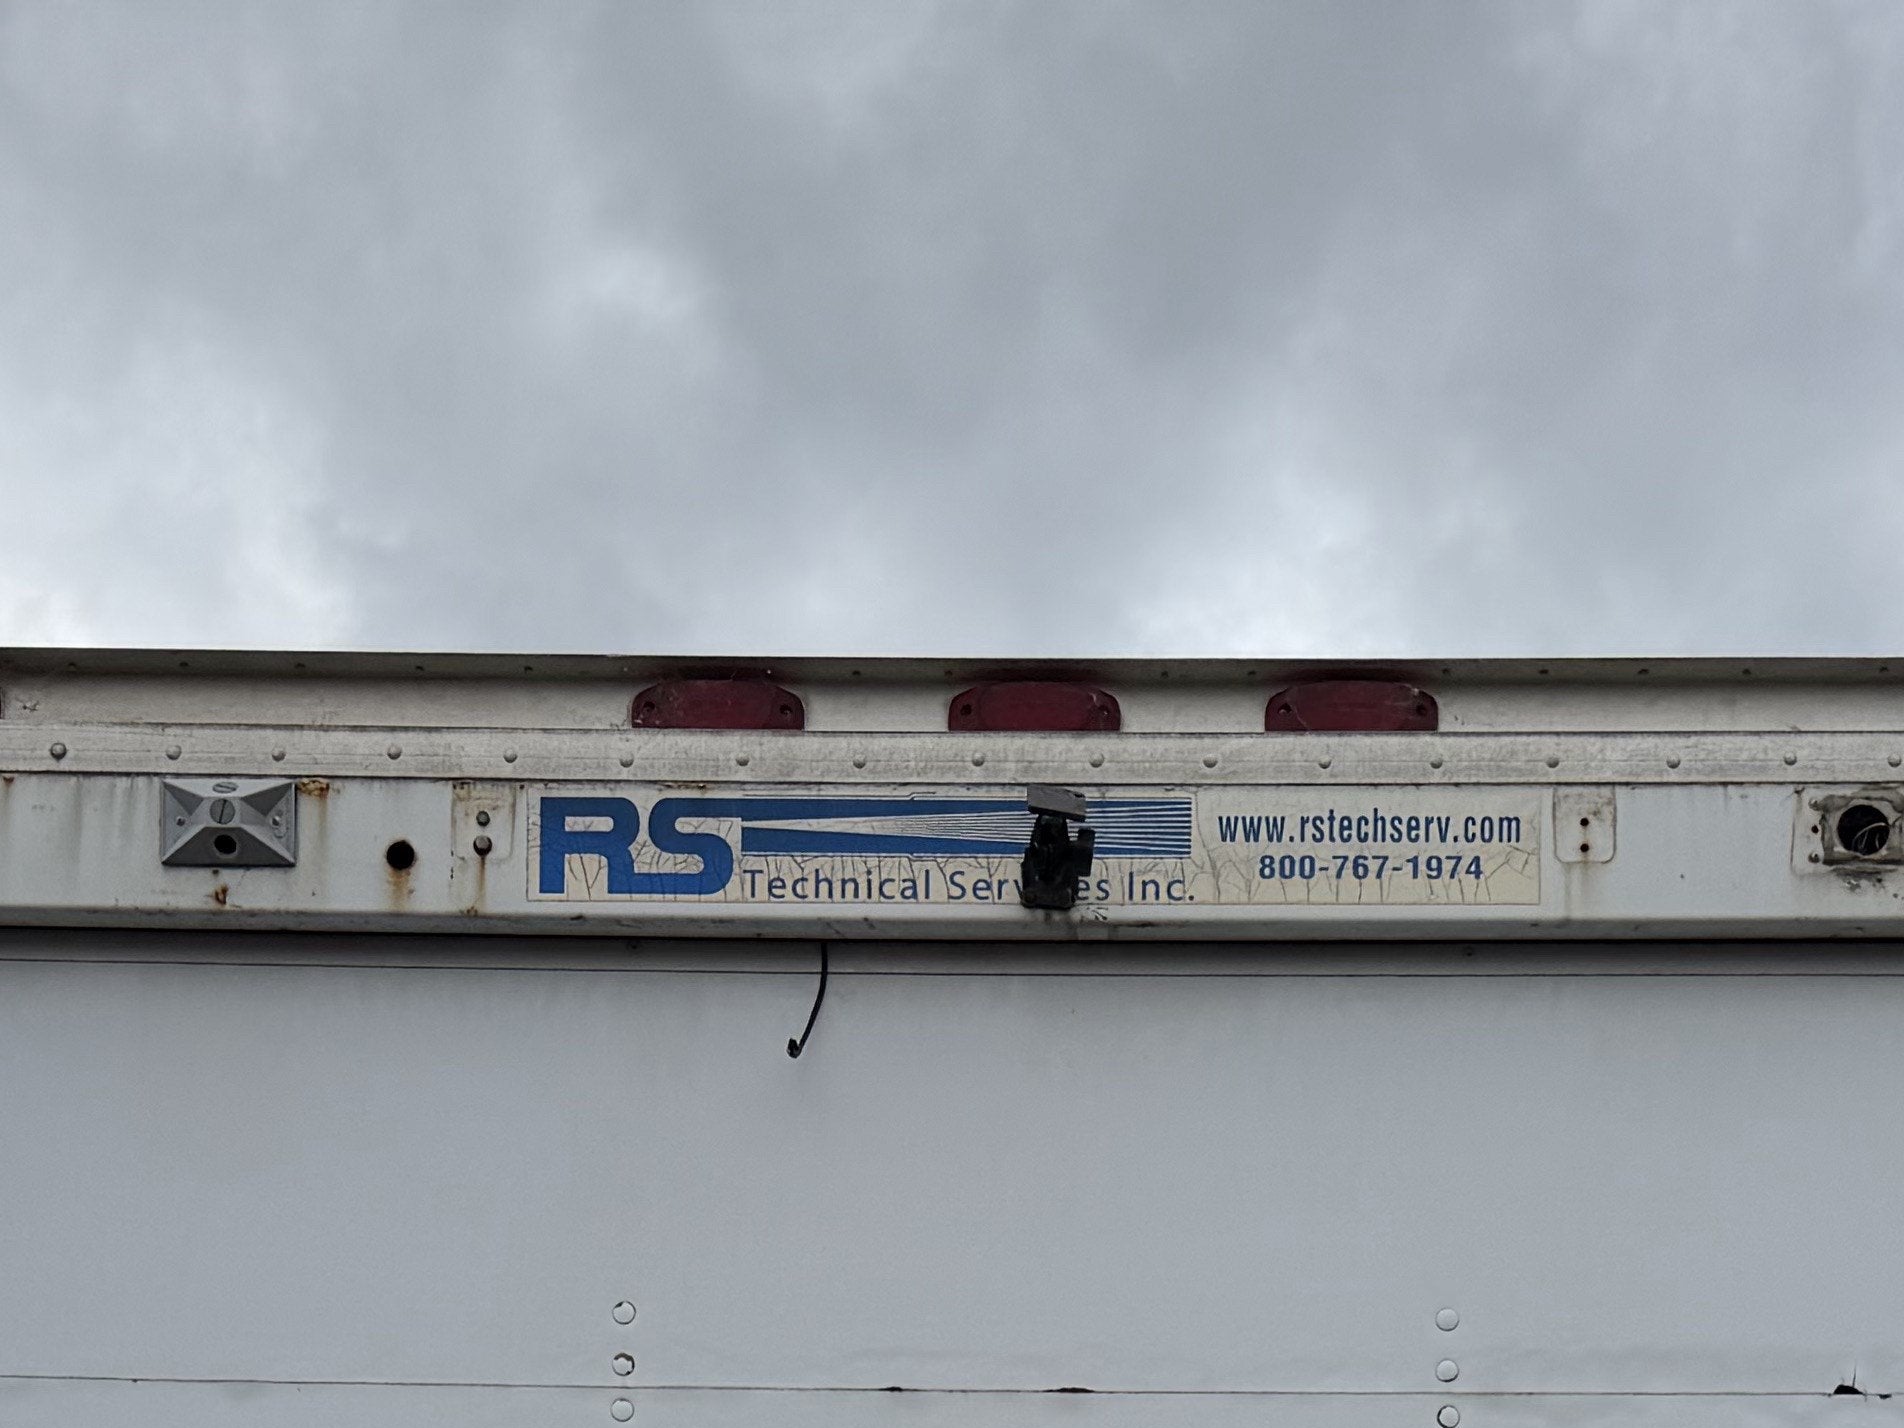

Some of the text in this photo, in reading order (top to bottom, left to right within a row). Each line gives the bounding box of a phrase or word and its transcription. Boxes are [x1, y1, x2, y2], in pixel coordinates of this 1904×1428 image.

[1217, 807, 1522, 844] www.rstechserv.com
[538, 796, 742, 896] RS
[1258, 854, 1484, 880] 800-767-1974
[743, 868, 1195, 902] Technical Seres Inc.
